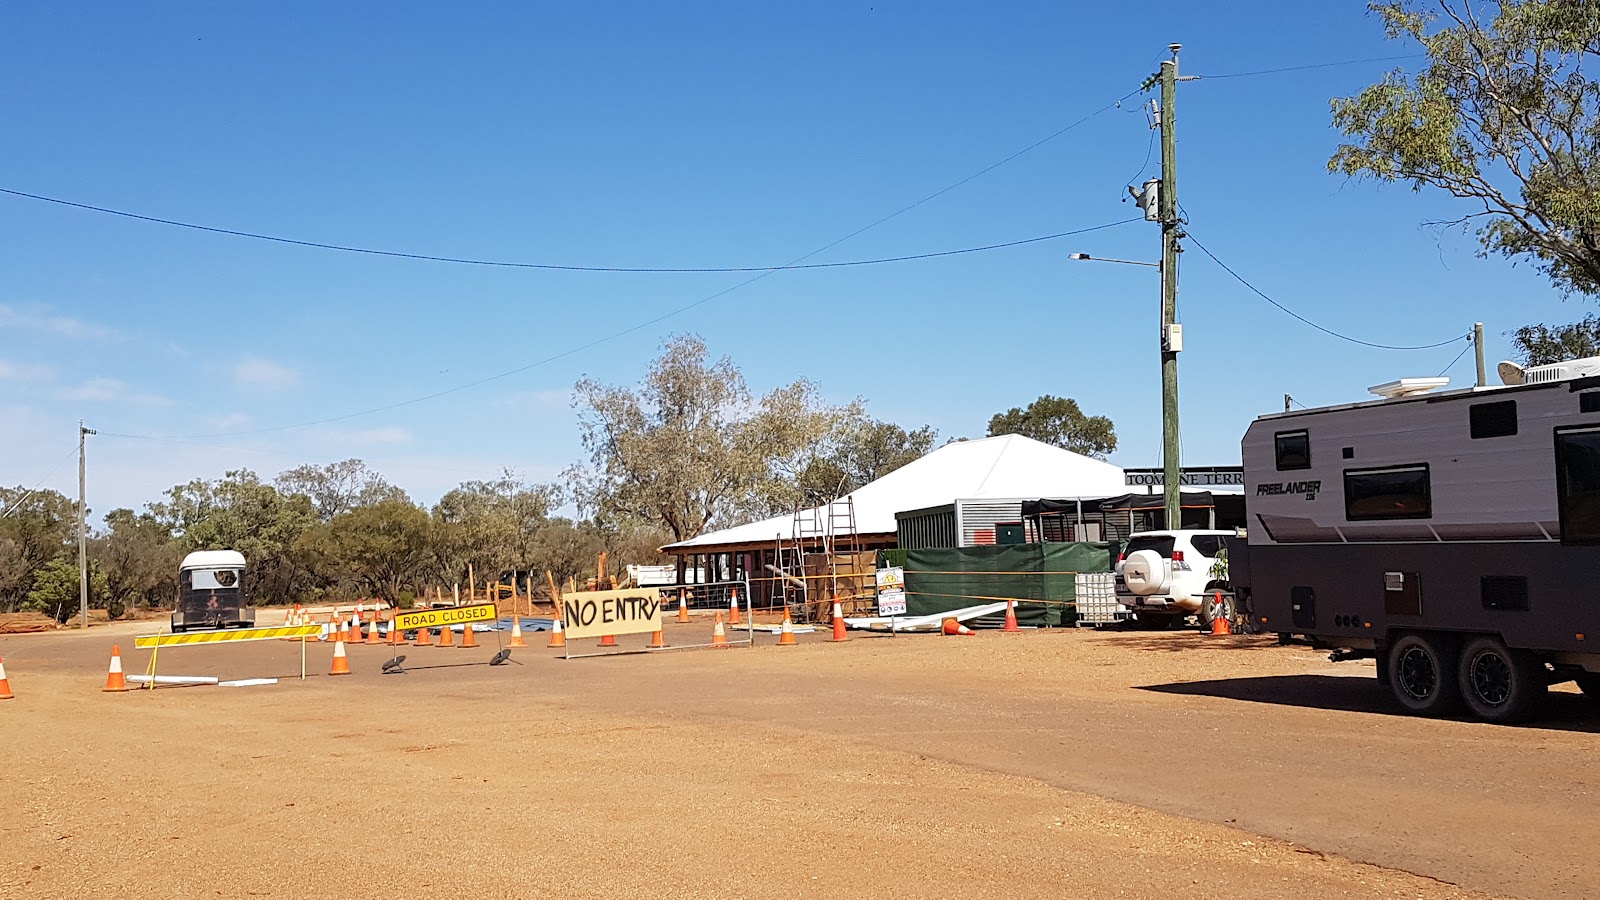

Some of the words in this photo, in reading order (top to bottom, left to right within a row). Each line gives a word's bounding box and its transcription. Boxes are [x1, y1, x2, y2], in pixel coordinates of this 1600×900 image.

[1127, 474, 1198, 485] TOOMNE
[1256, 480, 1322, 496] FREELANDER
[403, 614, 436, 626] ROAD
[442, 608, 488, 622] CLOSED
[565, 599, 597, 628] NO
[602, 596, 659, 622] ENTRY
